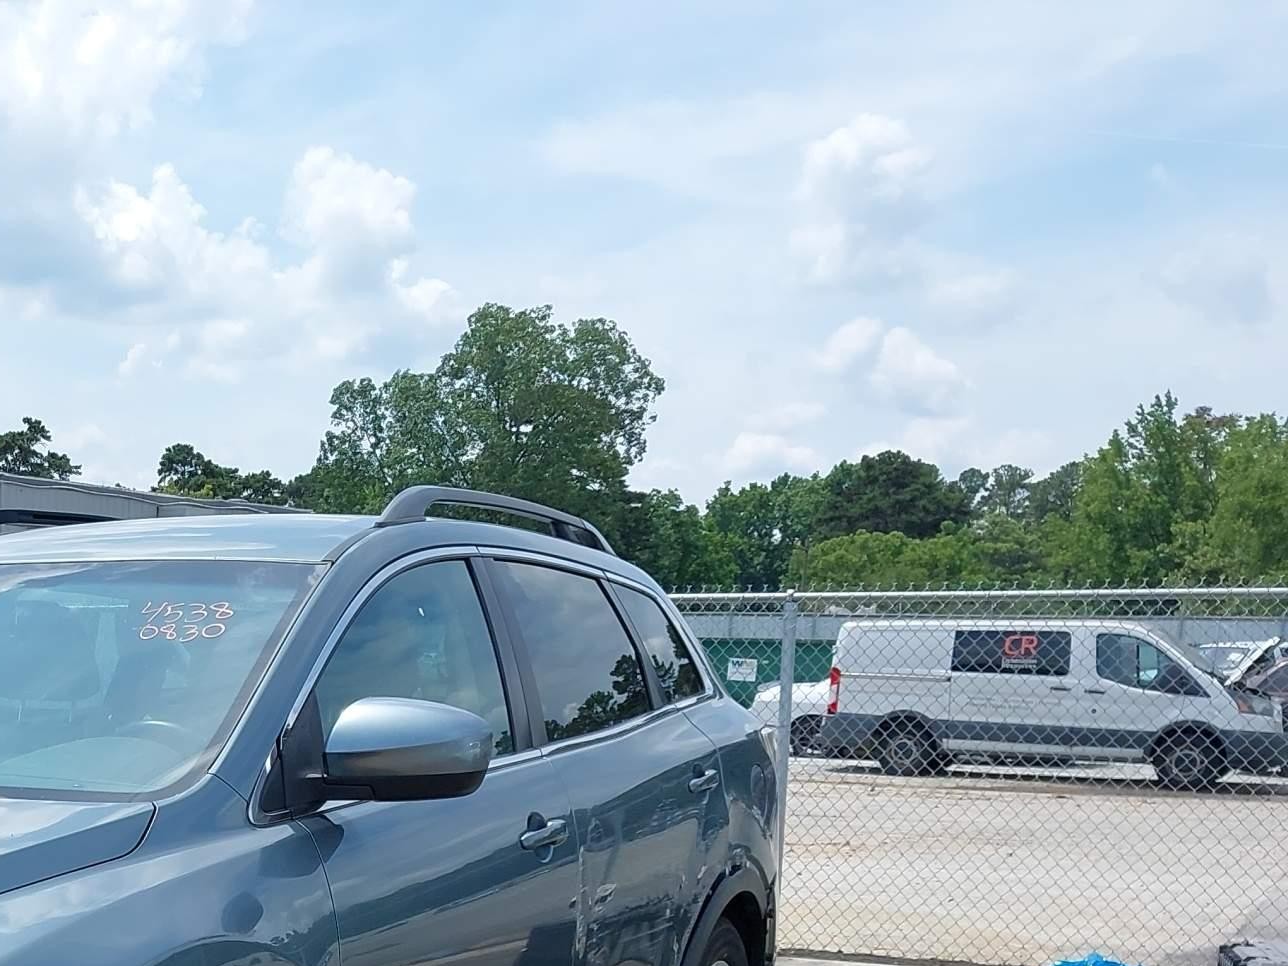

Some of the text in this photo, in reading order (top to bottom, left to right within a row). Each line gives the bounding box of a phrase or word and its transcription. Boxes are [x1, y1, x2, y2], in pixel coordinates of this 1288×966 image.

[140, 601, 234, 623] 4538
[139, 622, 227, 642] 0830
[1004, 635, 1038, 656] CR
